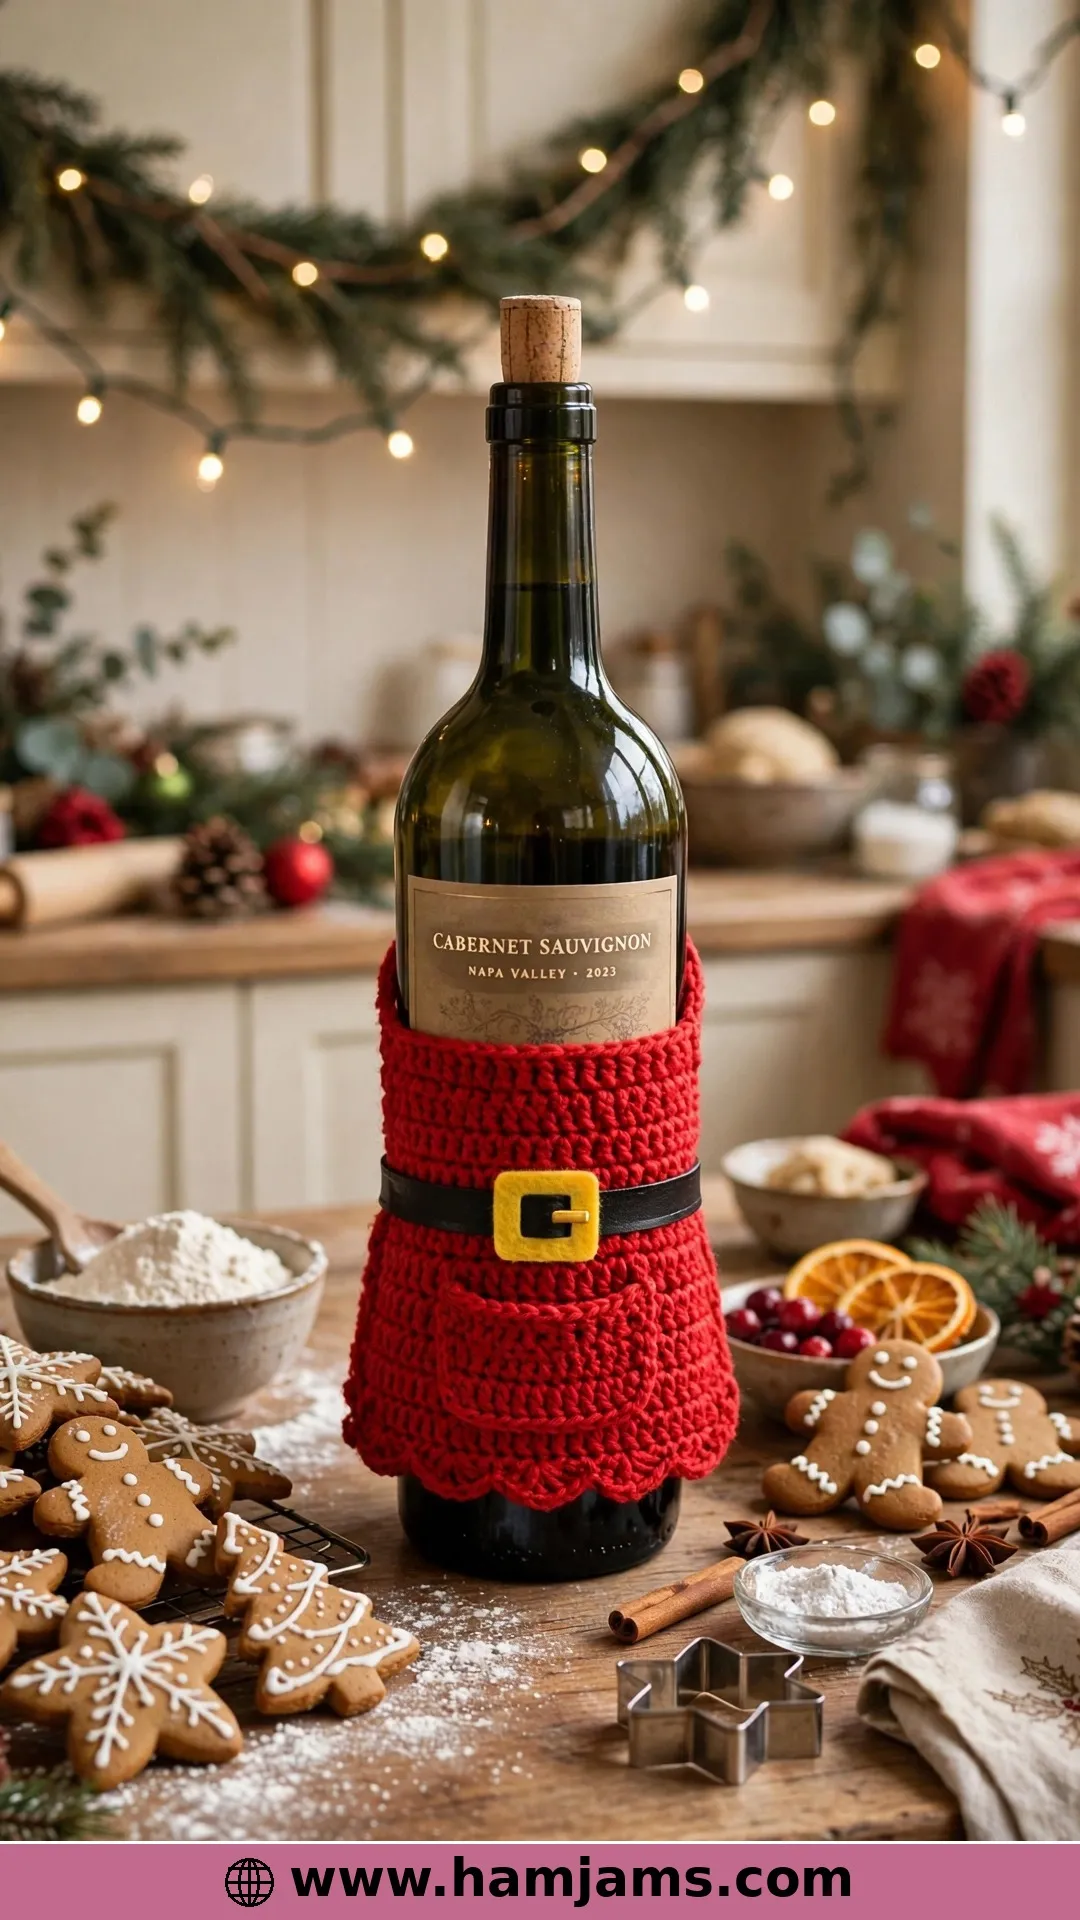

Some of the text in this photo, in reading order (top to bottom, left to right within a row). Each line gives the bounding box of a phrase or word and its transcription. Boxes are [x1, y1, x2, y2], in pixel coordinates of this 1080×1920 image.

[432, 932, 653, 955] CABERNET SAUVIGNON
[468, 965, 617, 980] NAPA VALLEY 2023
